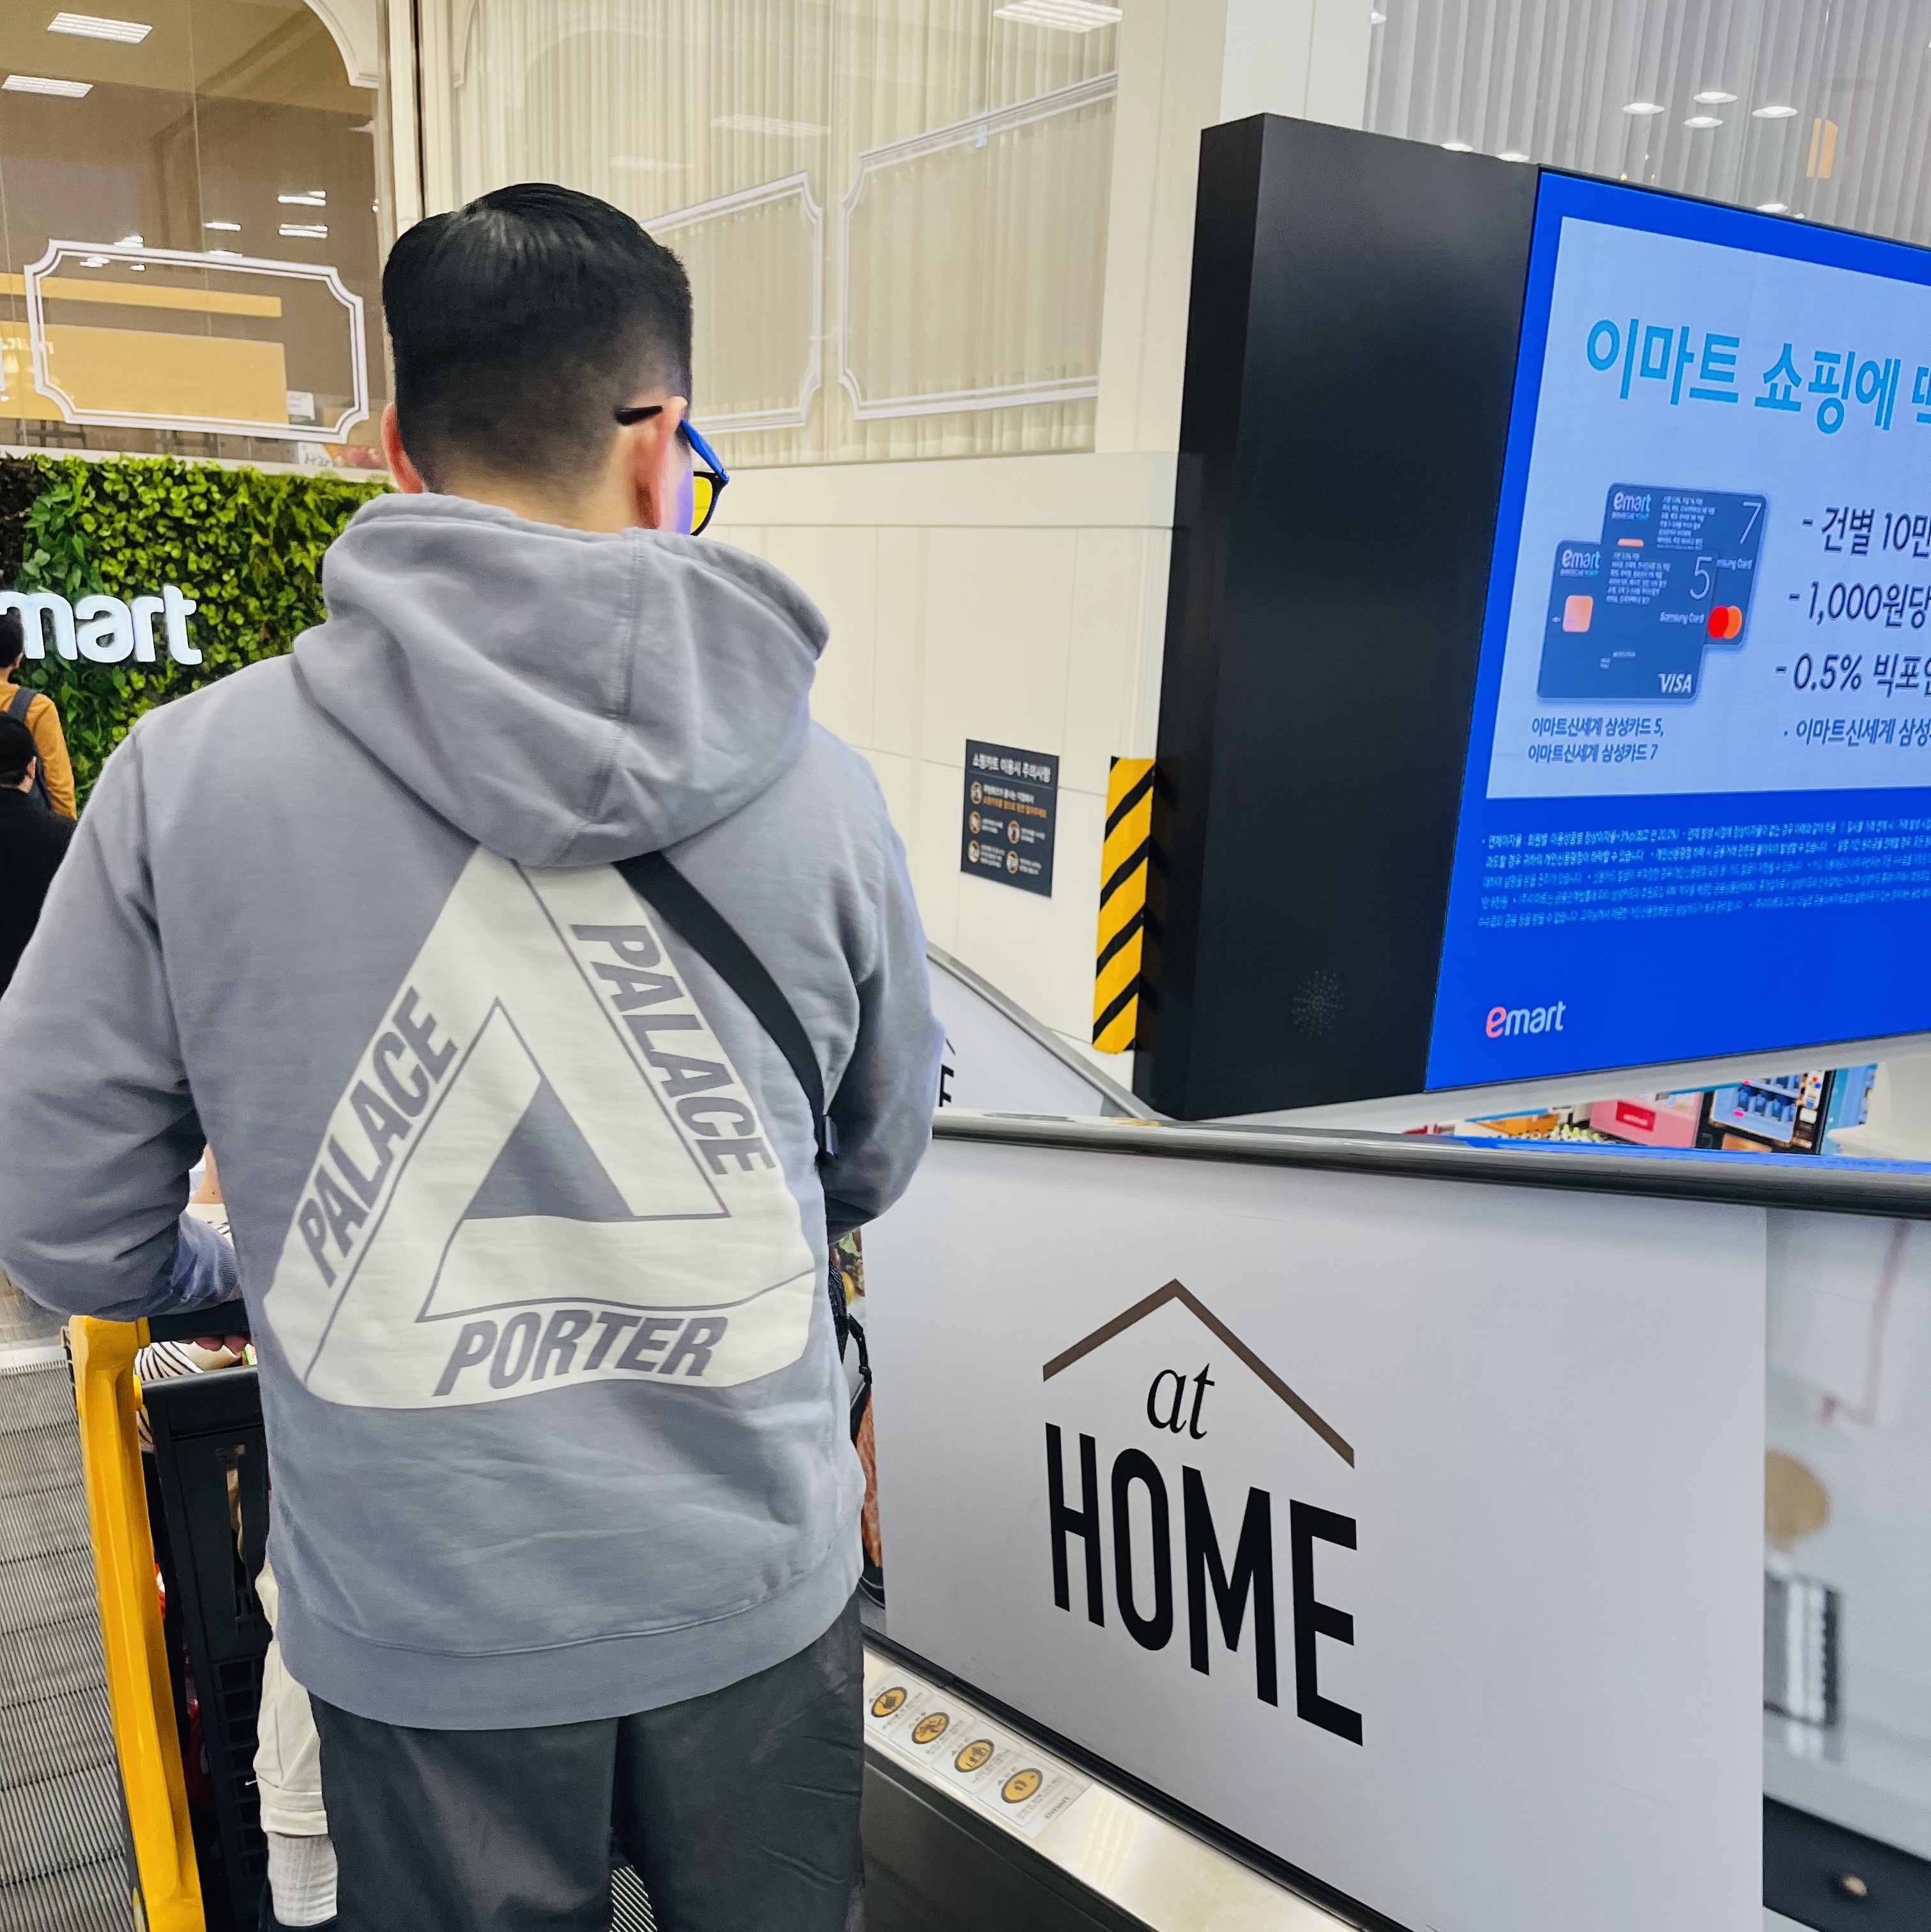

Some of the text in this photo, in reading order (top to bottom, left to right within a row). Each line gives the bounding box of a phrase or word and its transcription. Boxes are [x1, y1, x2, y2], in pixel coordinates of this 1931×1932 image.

[1587, 318, 1740, 405] 이마트
[1754, 343, 1901, 434] 쇼핑에
[1613, 491, 1651, 512] emart
[1740, 501, 1762, 545] 7
[1821, 506, 1875, 556] 건별
[1561, 549, 1601, 569] emart
[1690, 556, 1713, 600] 5
[1659, 611, 1705, 625] Samsung Card
[1808, 581, 1931, 629] 1,000원당
[1658, 673, 1693, 693] VISA
[1794, 653, 1863, 691] 0.5%
[1532, 717, 1603, 737] 이마트신세계
[1605, 717, 1651, 737] 삼성카드
[1796, 718, 1931, 747] 이마트신세계 삼성
[1528, 744, 1658, 763] 이마트신세계 삼성카드 7
[1486, 1000, 1566, 1038] emart
[570, 924, 776, 1175] PALACE
[297, 986, 459, 1289] PALACE
[432, 1309, 729, 1397] PORTER
[1147, 1363, 1215, 1439] at
[1046, 1422, 1363, 1746] HOME
